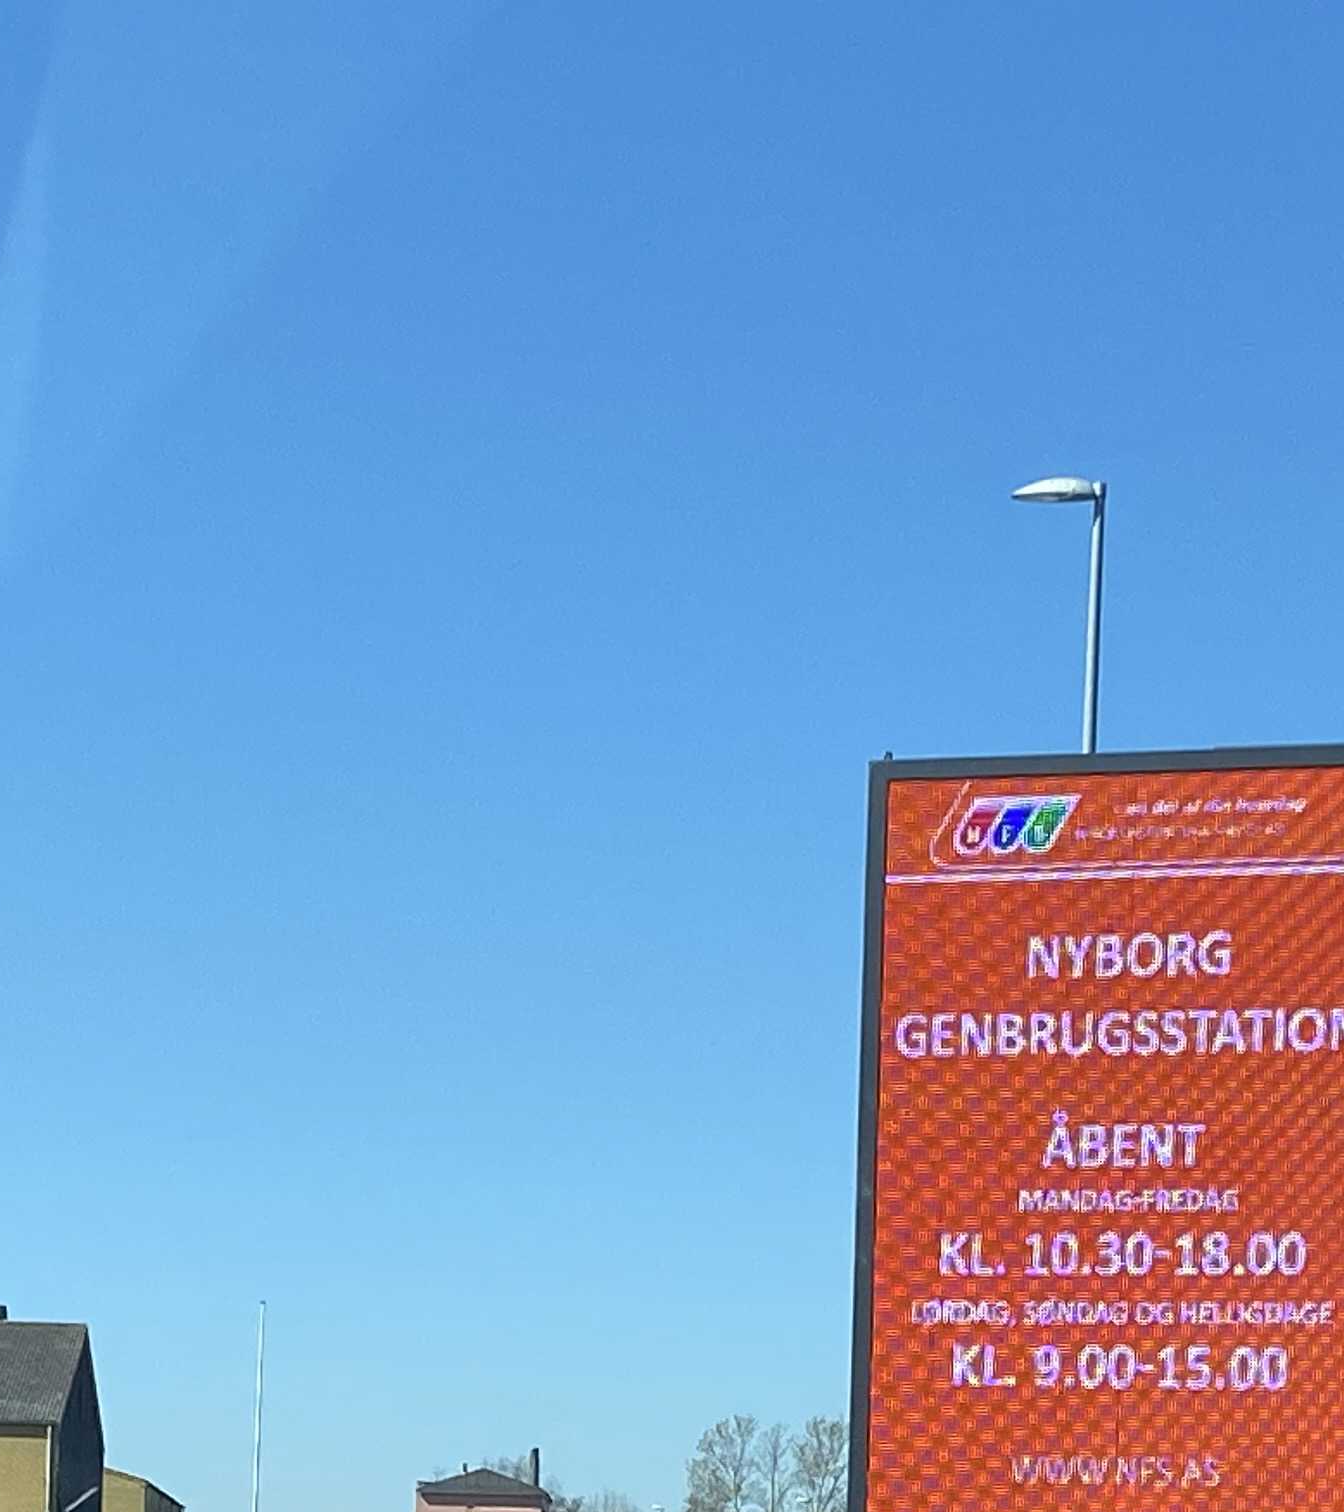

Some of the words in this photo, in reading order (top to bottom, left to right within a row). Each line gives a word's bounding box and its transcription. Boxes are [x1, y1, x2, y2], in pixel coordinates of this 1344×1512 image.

[1028, 930, 1233, 979] NYBORG
[1043, 1110, 1206, 1168] ÅBENT
[939, 1231, 1006, 1277] KL.
[1023, 1230, 1308, 1277] 10.30-18.00
[1135, 1301, 1175, 1326] OG
[952, 1344, 1016, 1389] KL.
[1033, 1344, 1288, 1391] 9.00-15.00
